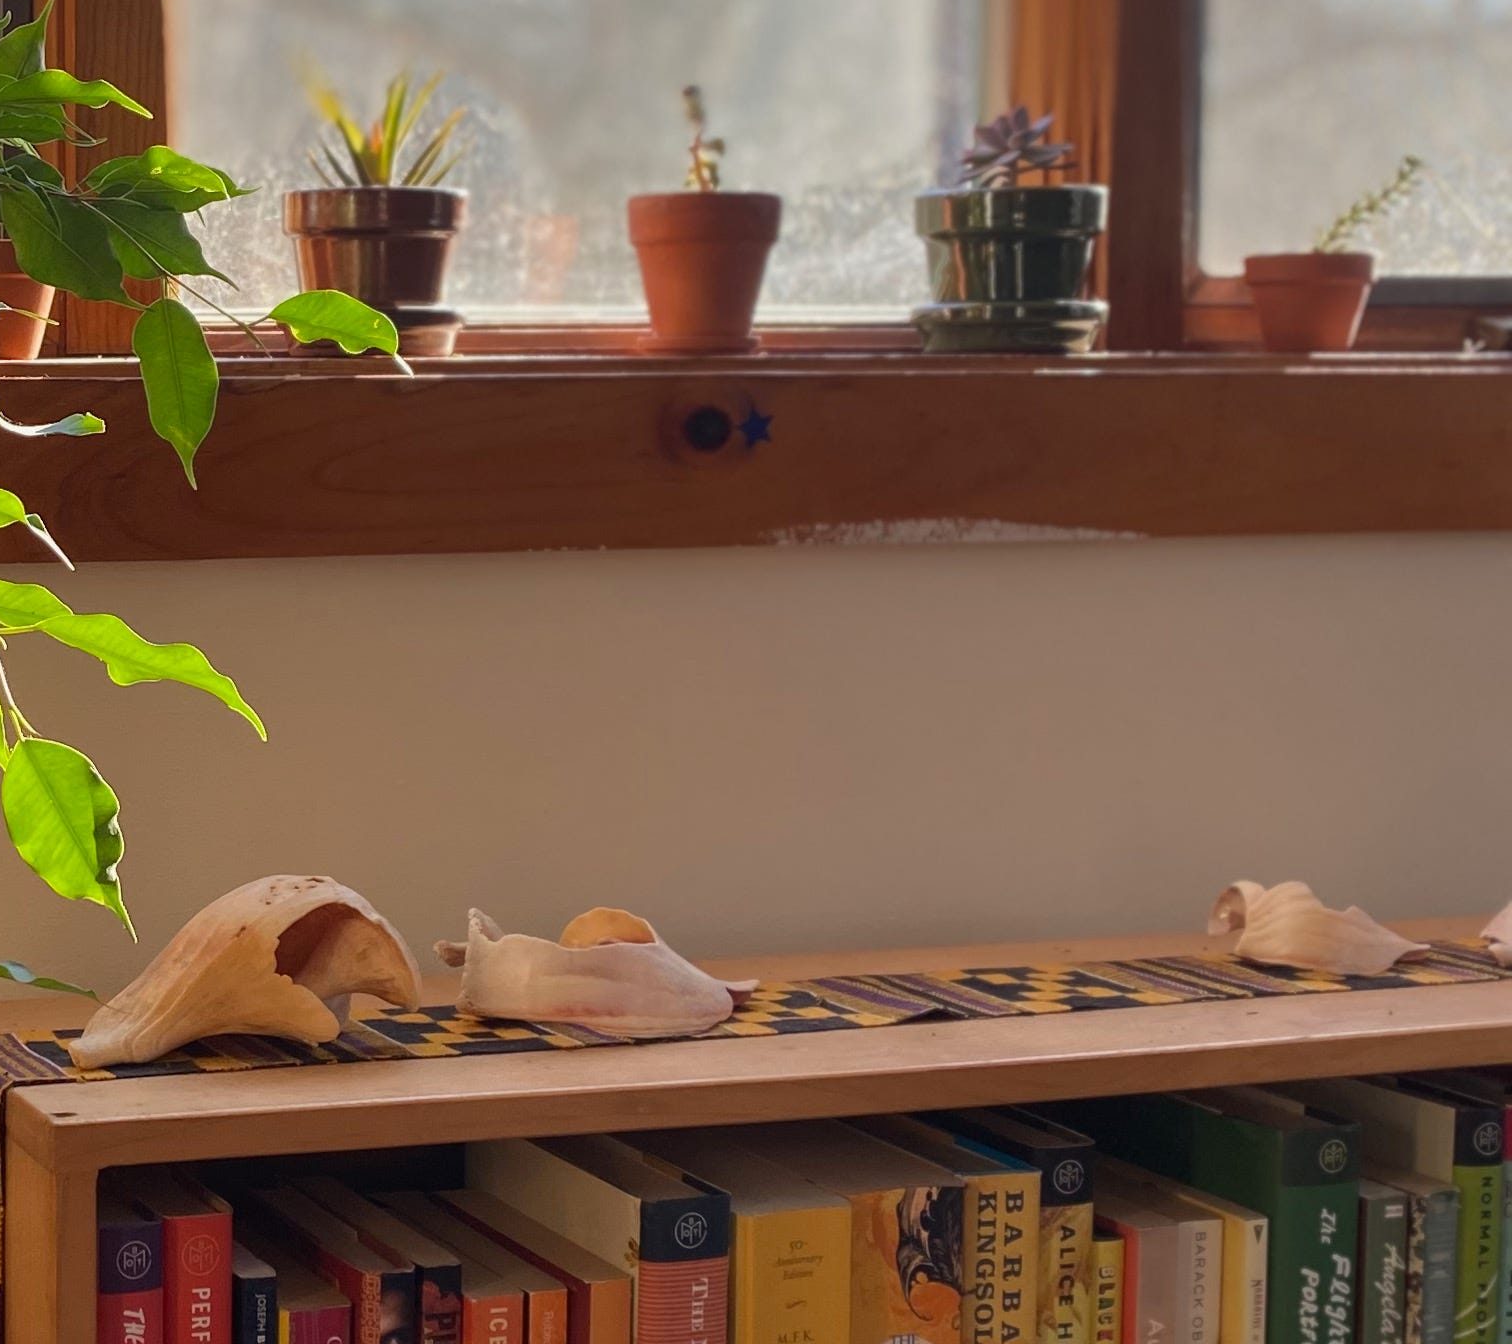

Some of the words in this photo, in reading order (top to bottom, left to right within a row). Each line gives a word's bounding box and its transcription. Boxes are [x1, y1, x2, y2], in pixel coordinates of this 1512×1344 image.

[1319, 1207, 1337, 1245] The
[1476, 1175, 1494, 1271] NORMAL
[1059, 1223, 1076, 1307] ALICE
[1096, 1265, 1116, 1342] BLACK
[1193, 1231, 1207, 1309] BARACK
[1373, 1242, 1406, 1337] Angela
[255, 1293, 267, 1332] JOSEPH
